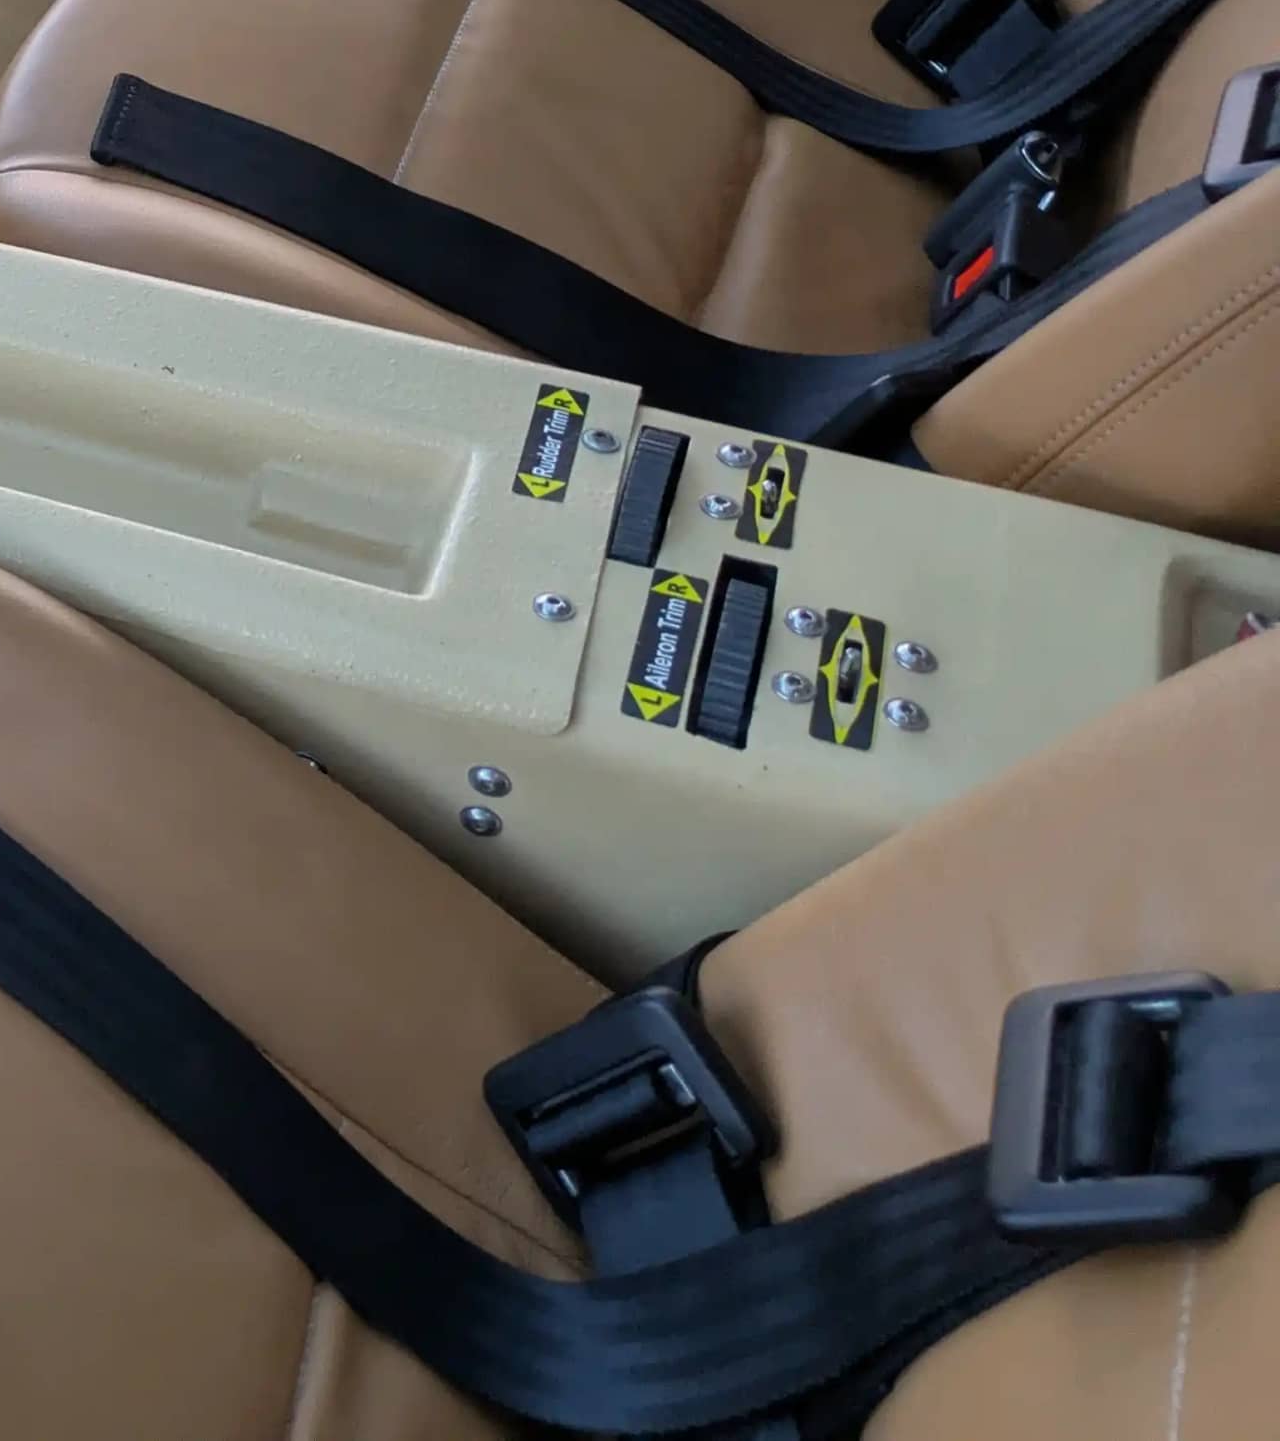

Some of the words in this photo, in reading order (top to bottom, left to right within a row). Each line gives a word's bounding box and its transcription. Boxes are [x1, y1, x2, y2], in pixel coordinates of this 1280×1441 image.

[553, 396, 574, 409] R
[543, 407, 570, 443] Trim
[532, 434, 563, 479] Rudder
[531, 476, 550, 489] L
[667, 581, 689, 596] R
[656, 594, 688, 633] Trim
[643, 629, 679, 690] Aileron
[641, 692, 663, 707] L
